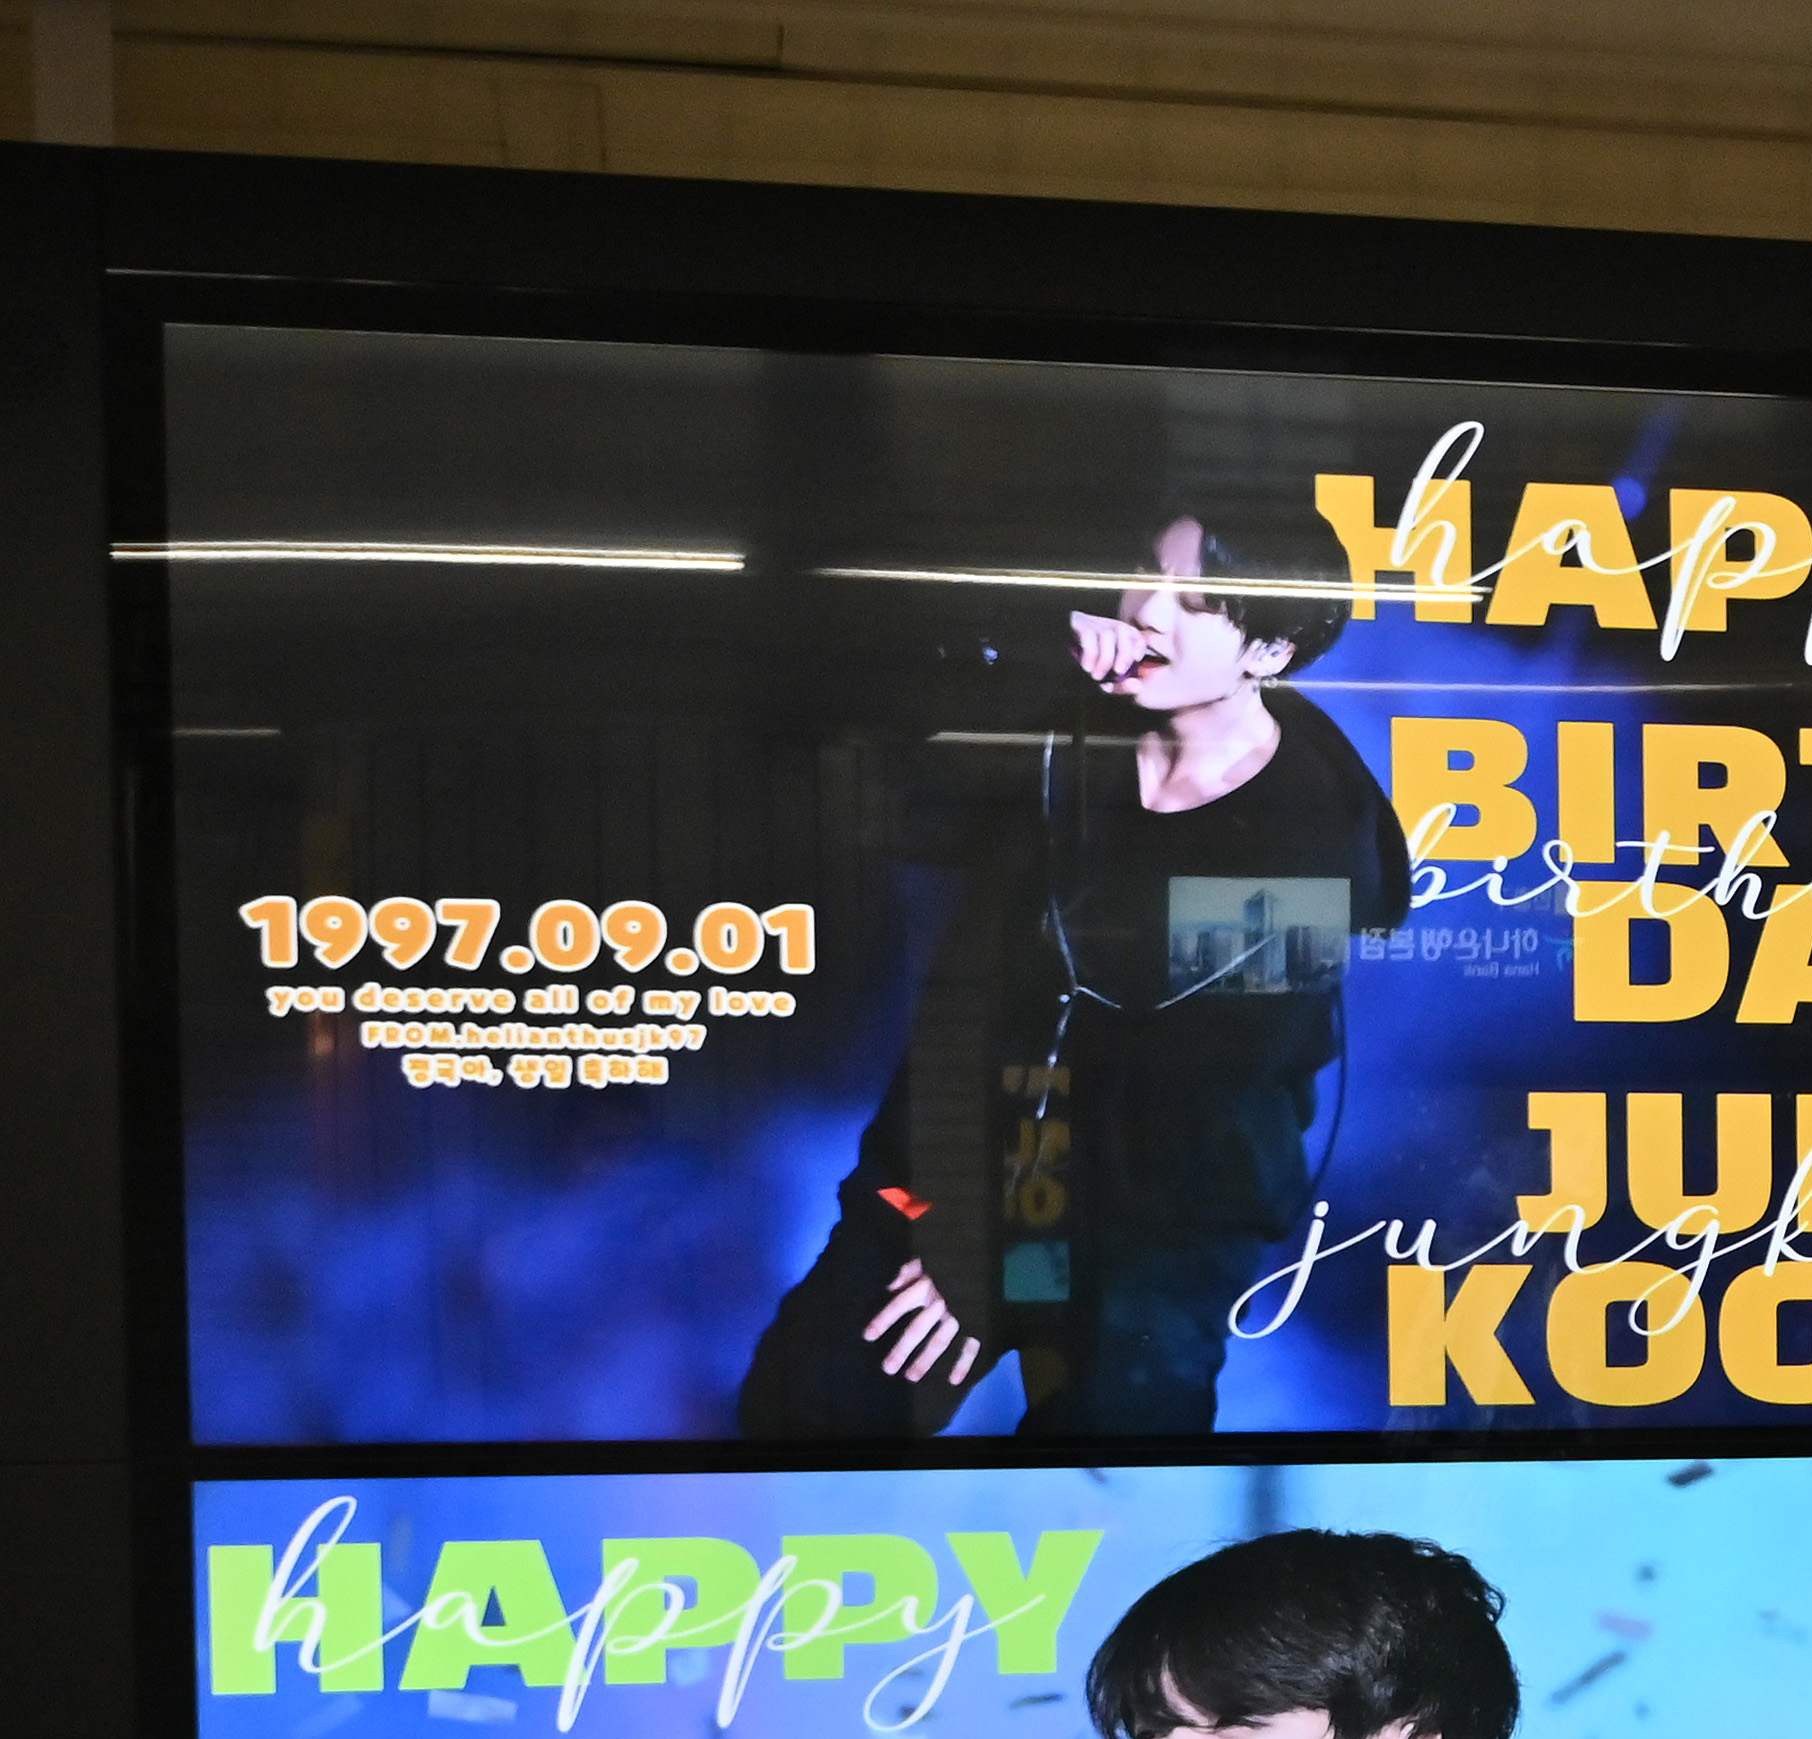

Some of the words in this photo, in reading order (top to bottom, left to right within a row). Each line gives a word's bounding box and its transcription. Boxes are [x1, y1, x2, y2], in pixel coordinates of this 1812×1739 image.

[238, 894, 816, 975] 1997.09.01
[266, 985, 345, 1018] you
[352, 982, 516, 1015] deserve
[523, 984, 579, 1015] all
[586, 984, 635, 1015] of
[642, 989, 700, 1019] my
[707, 986, 796, 1016] love
[507, 1053, 573, 1087] 생일
[208, 1529, 1105, 1695] HAPPY
[253, 1495, 1047, 1734] happy
